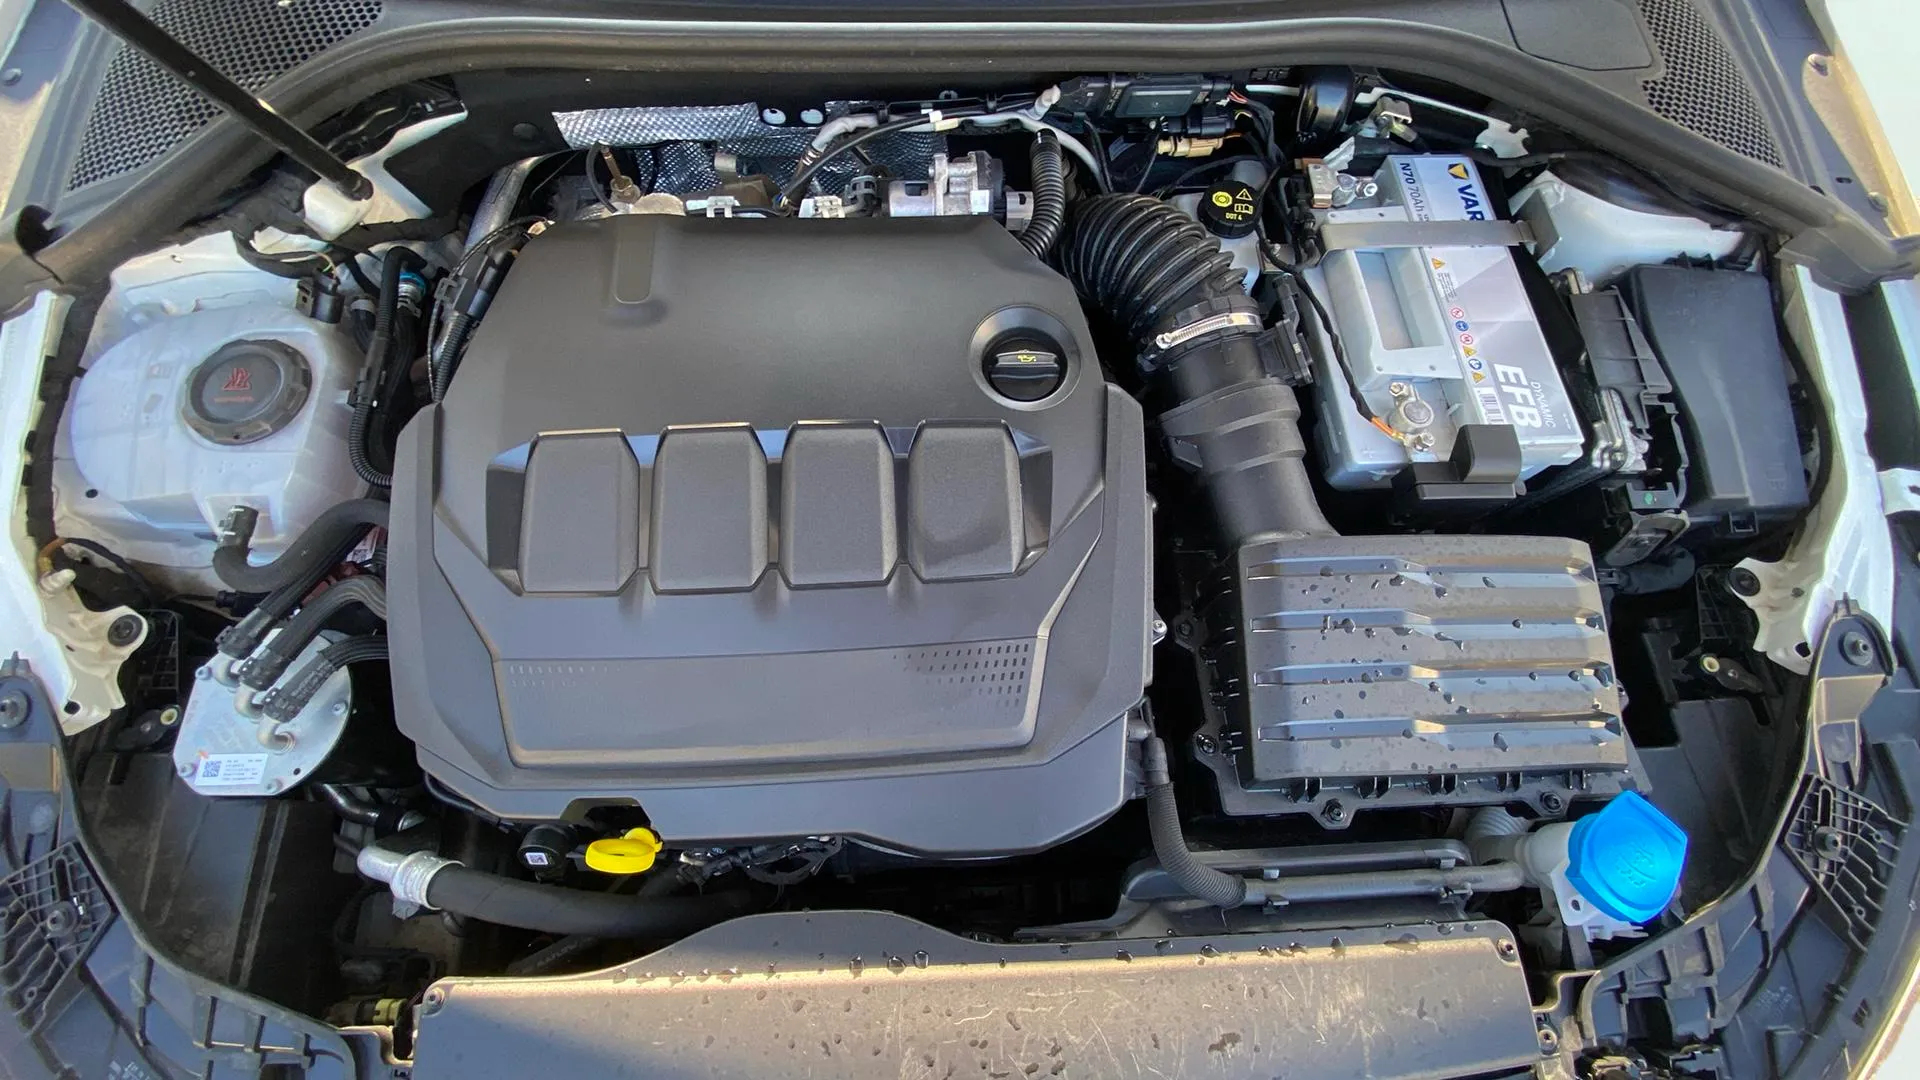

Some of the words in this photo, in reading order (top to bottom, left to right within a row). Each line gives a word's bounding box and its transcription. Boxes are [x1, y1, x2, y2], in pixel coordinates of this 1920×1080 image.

[1400, 162, 1416, 185] N70
[1408, 186, 1424, 212] 70Ah
[1493, 363, 1542, 429] EFB
[1530, 381, 1556, 428] DYNAMIC
